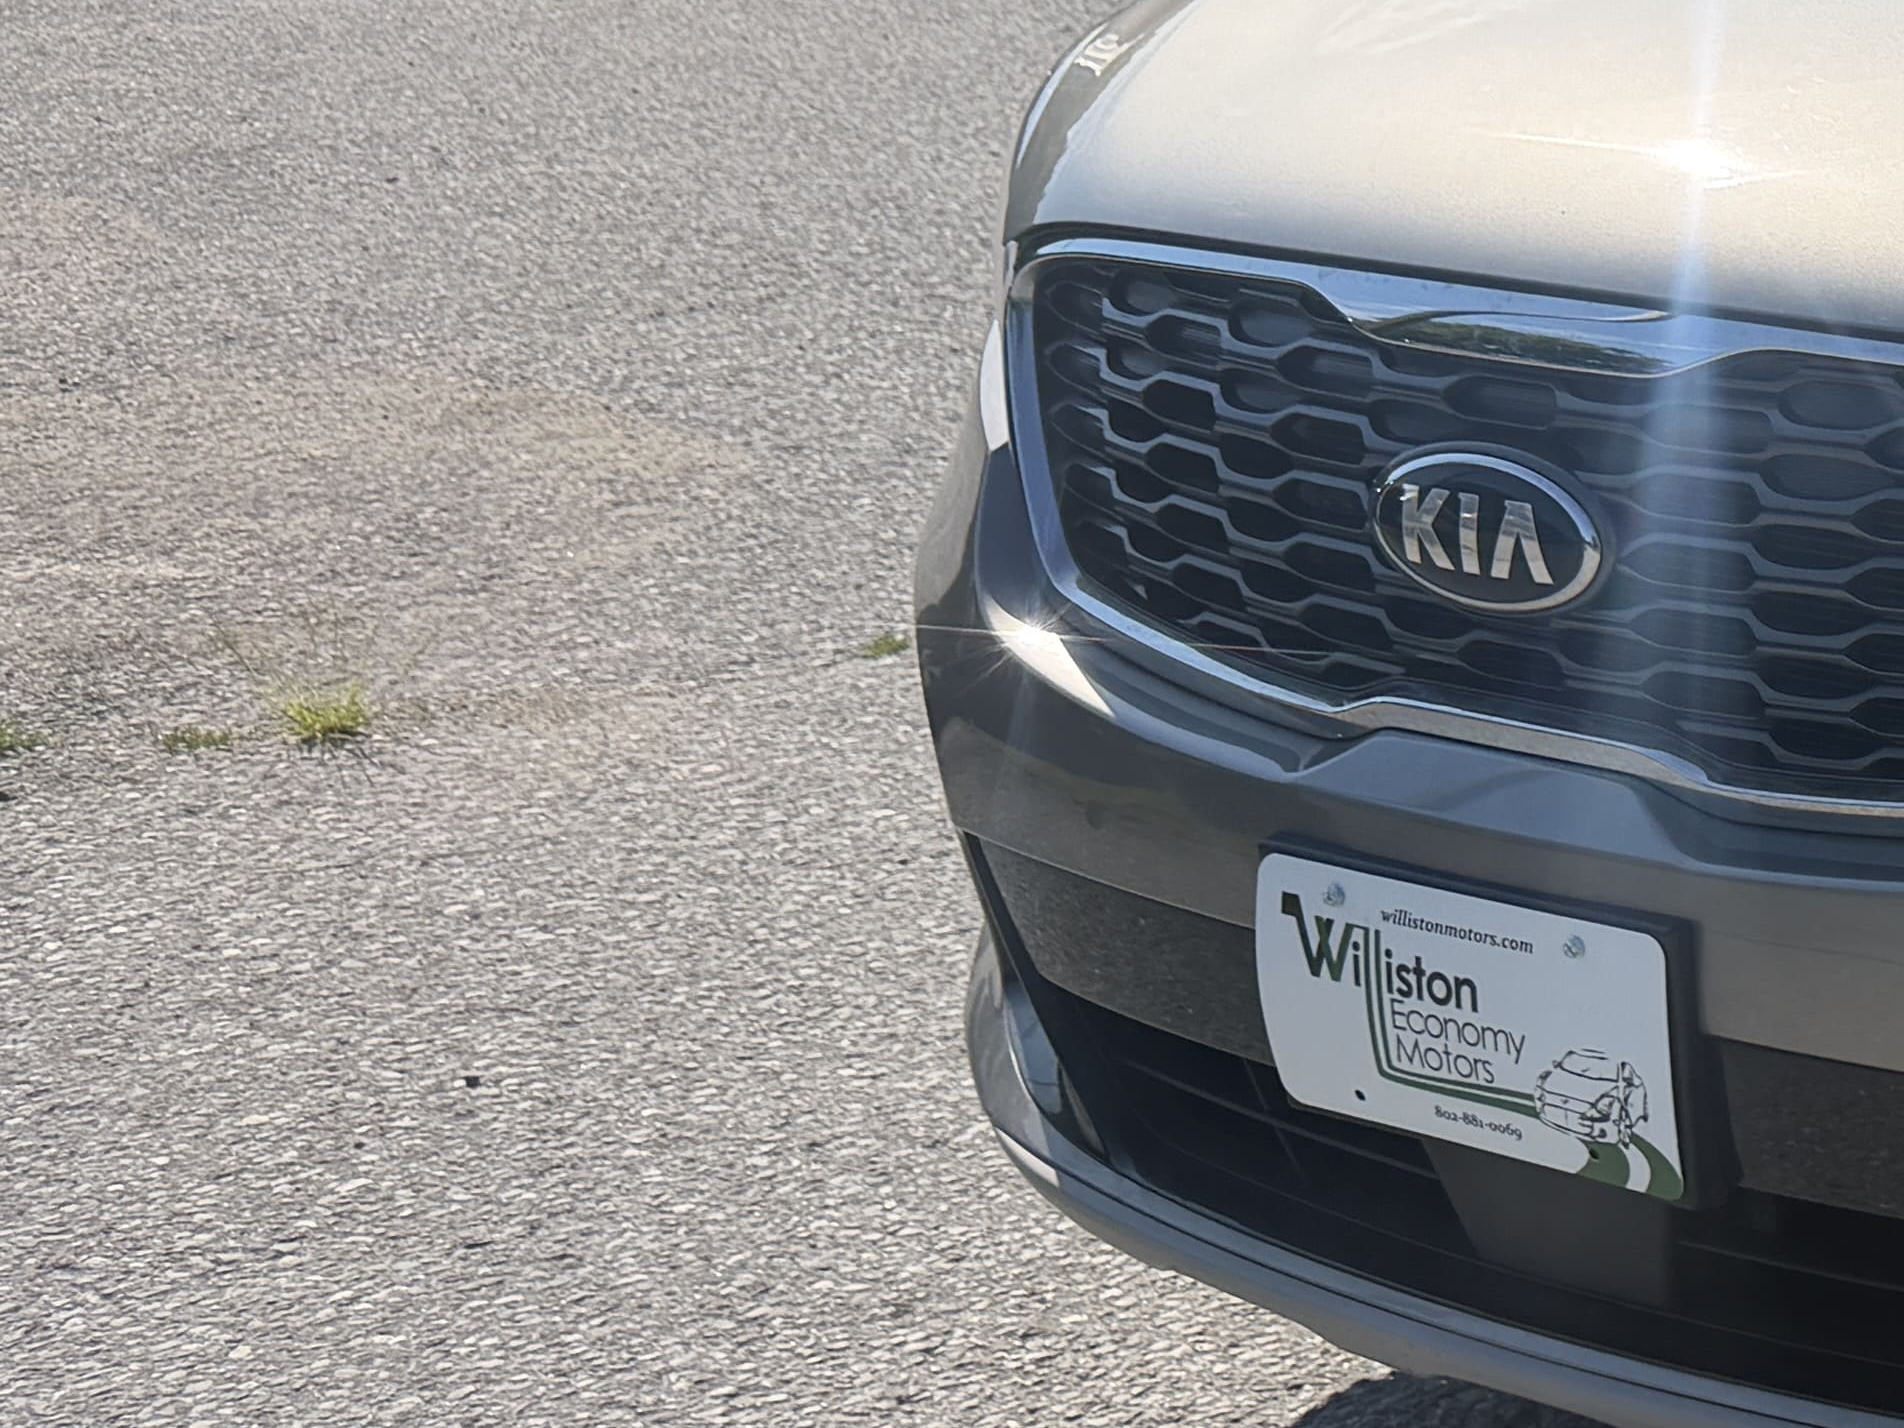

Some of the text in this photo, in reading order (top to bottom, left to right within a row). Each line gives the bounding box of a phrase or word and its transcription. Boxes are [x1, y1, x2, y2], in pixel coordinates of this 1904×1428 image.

[1399, 482, 1554, 585] KIA
[1281, 891, 1480, 1014] Williston
[1380, 908, 1534, 954] willistonmotors.com
[1390, 999, 1526, 1065] Economy
[1396, 1034, 1496, 1085] Motors
[1434, 1104, 1523, 1141] 802-881-0069
